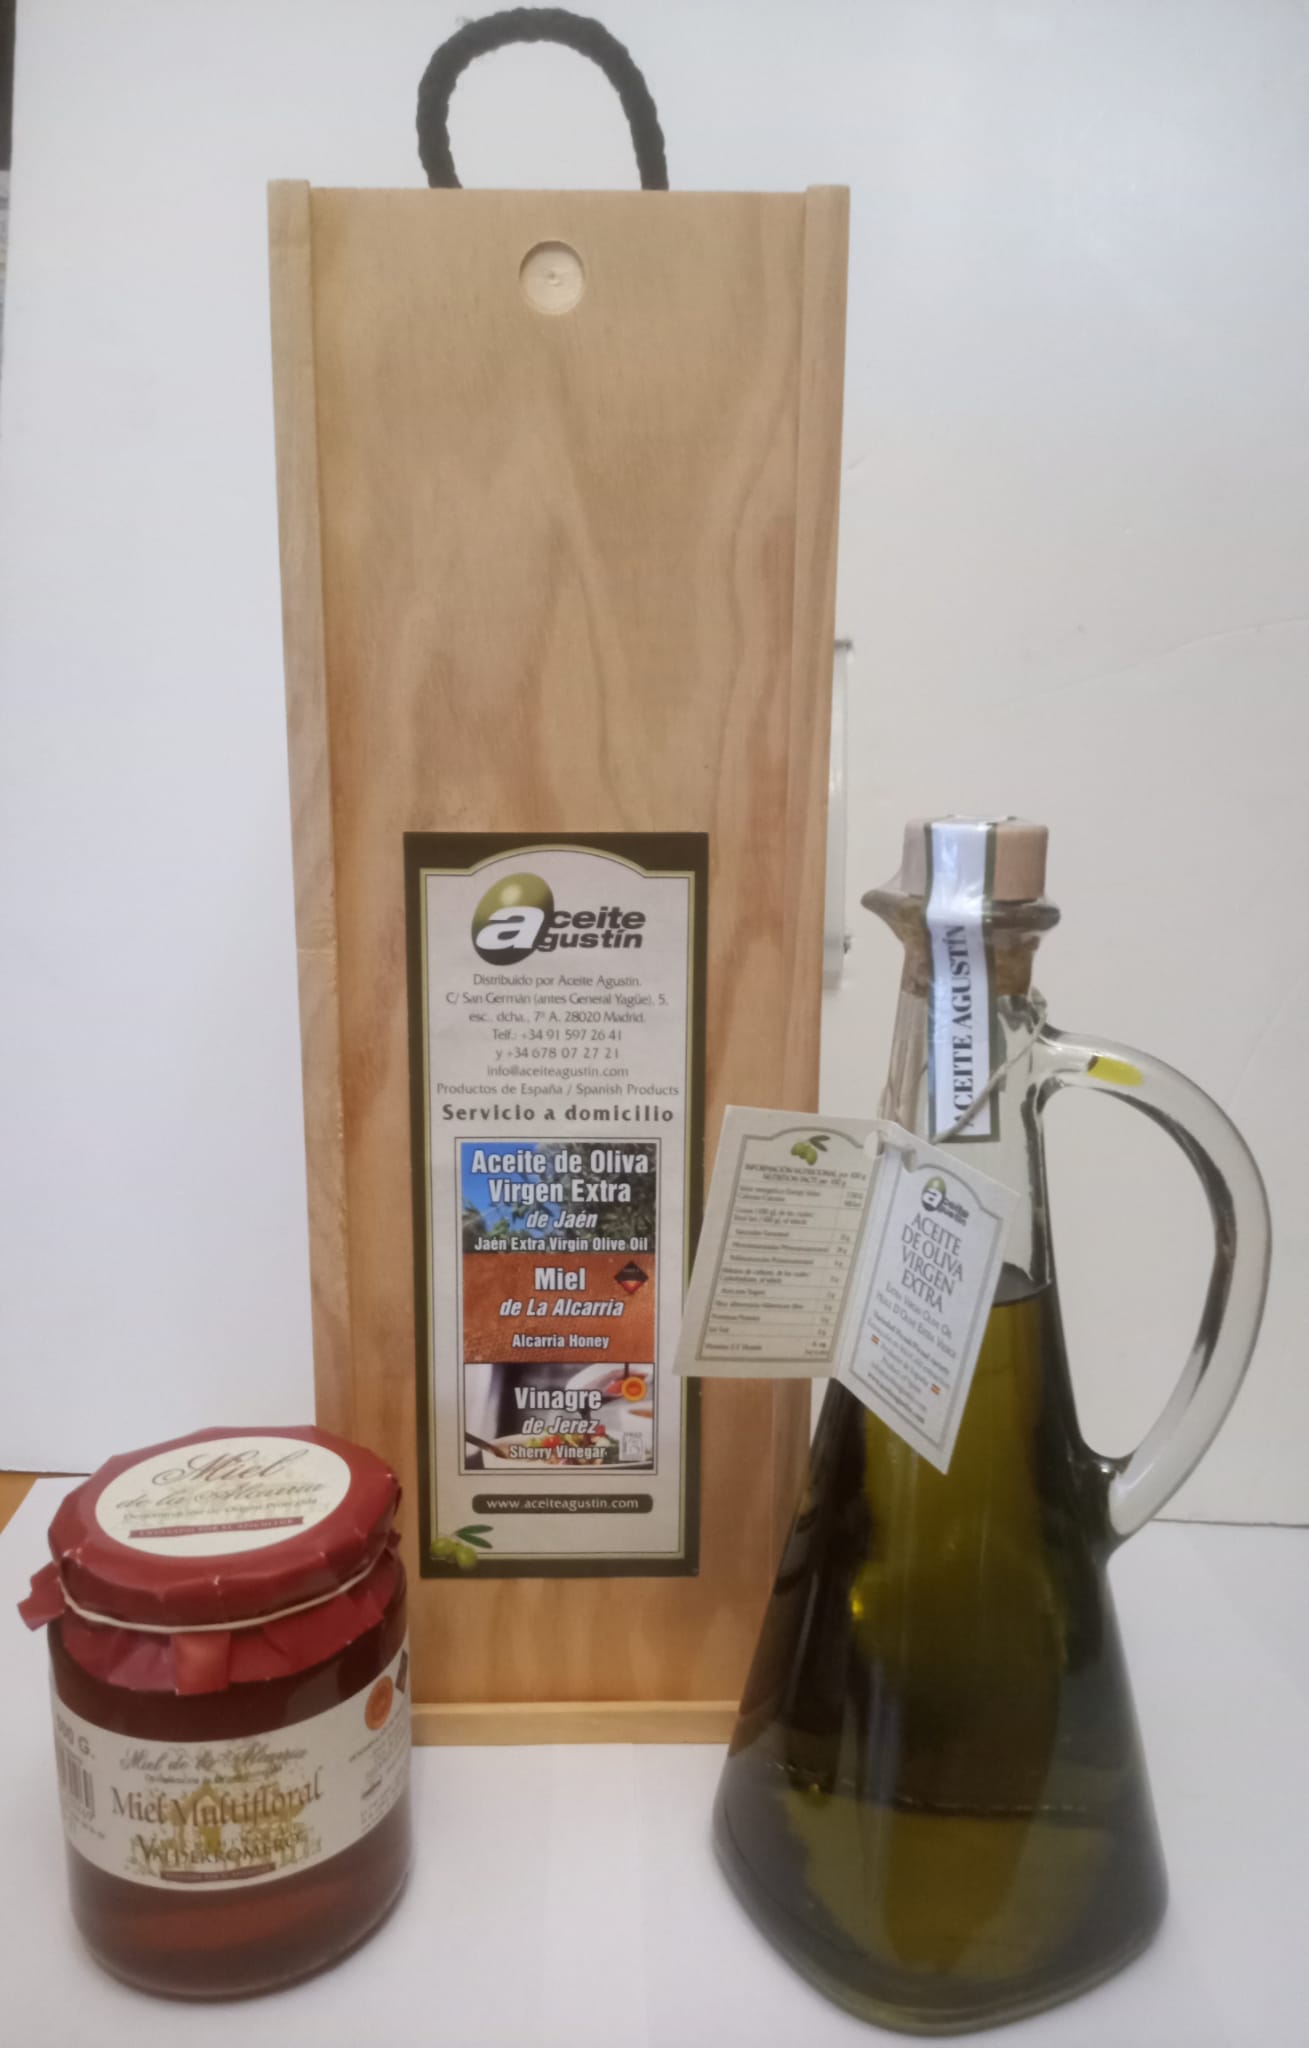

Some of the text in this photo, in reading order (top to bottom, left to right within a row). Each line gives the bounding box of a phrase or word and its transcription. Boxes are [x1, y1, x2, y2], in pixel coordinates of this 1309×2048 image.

[473, 974, 532, 986] Distribuido
[536, 977, 554, 988] por
[559, 976, 592, 986] Aceite
[446, 993, 460, 1004] C/
[462, 993, 482, 1004] San
[486, 993, 531, 1004] Germán
[534, 993, 566, 1005] (antes
[570, 993, 612, 1005] General
[615, 993, 656, 1007] Yagüe),
[564, 1012, 601, 1023] 28020
[604, 1012, 646, 1023] Madrid.
[520, 1029, 543, 1040] +34
[546, 1029, 560, 1040] 91
[565, 1030, 588, 1041] 597
[591, 1030, 606, 1041] 26
[608, 1030, 622, 1041] 41
[496, 1048, 619, 1062] y +34 678 07 27 21
[487, 1066, 628, 1080] info@aceiteagustin.com
[437, 1084, 497, 1095] Productos
[501, 1084, 518, 1095] de
[521, 1084, 563, 1096] España
[576, 1085, 622, 1098] Spanish
[627, 1085, 679, 1096] Products
[442, 1104, 673, 1122] Servicio a domicilio
[471, 1150, 649, 1175] Aceite de Oliva
[488, 1178, 631, 1206] Virgen Extra
[527, 1210, 598, 1229] de Jaén
[911, 1213, 963, 1255] ACEITE
[474, 1236, 648, 1254] Jaén Extra Virgin Olive Oil
[902, 1225, 964, 1283] DE OLIVA
[534, 1267, 586, 1291] Miel
[902, 1251, 957, 1296] VIRGEN
[902, 1272, 943, 1314] EXTRA
[500, 1299, 625, 1317] de La Alcarria
[512, 1334, 610, 1351] Alcarria Honey
[515, 1386, 602, 1412] Vinagre
[522, 1417, 599, 1435] de Jerez
[509, 1444, 553, 1461] Sherry
[556, 1445, 607, 1462] Vinegar
[152, 1448, 309, 1486] Miel
[116, 1494, 150, 1510] de
[487, 1496, 639, 1512] www.aceiteagustin.com
[111, 1786, 166, 1824] Miel
[171, 1765, 324, 1827] Multifloral
